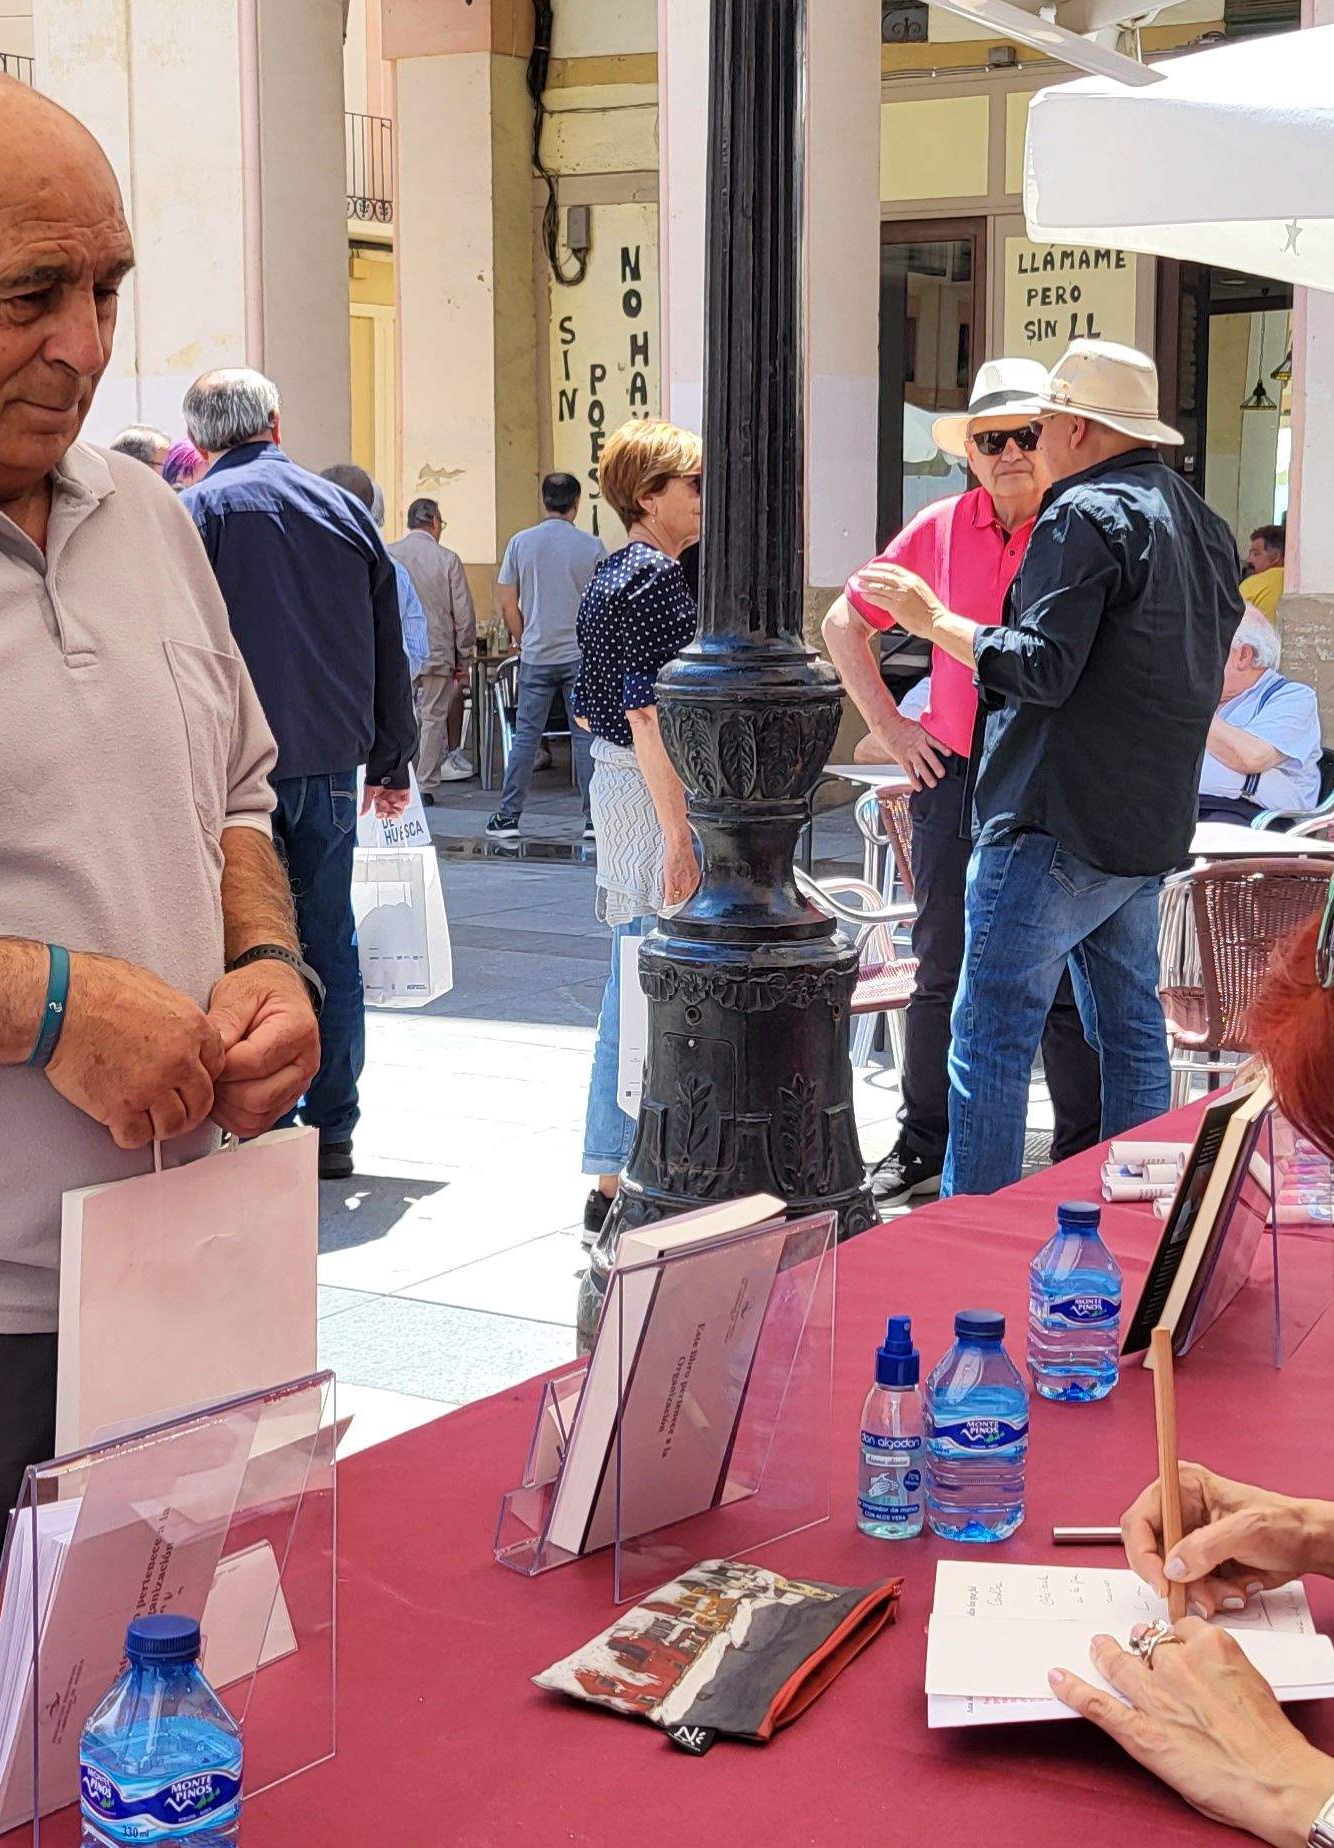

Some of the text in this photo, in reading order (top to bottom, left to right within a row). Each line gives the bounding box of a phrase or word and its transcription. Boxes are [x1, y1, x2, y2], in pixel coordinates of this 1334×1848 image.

[1017, 244, 1127, 274] LLÁMAME
[1026, 284, 1082, 307] PERO
[1024, 312, 1102, 342] SIN LL
[384, 820, 424, 845] HUESCA
[966, 1420, 999, 1429] MONTE
[171, 1774, 213, 1795] MONTE
[175, 1785, 214, 1802] PINOS
[121, 1825, 139, 1838] 330
